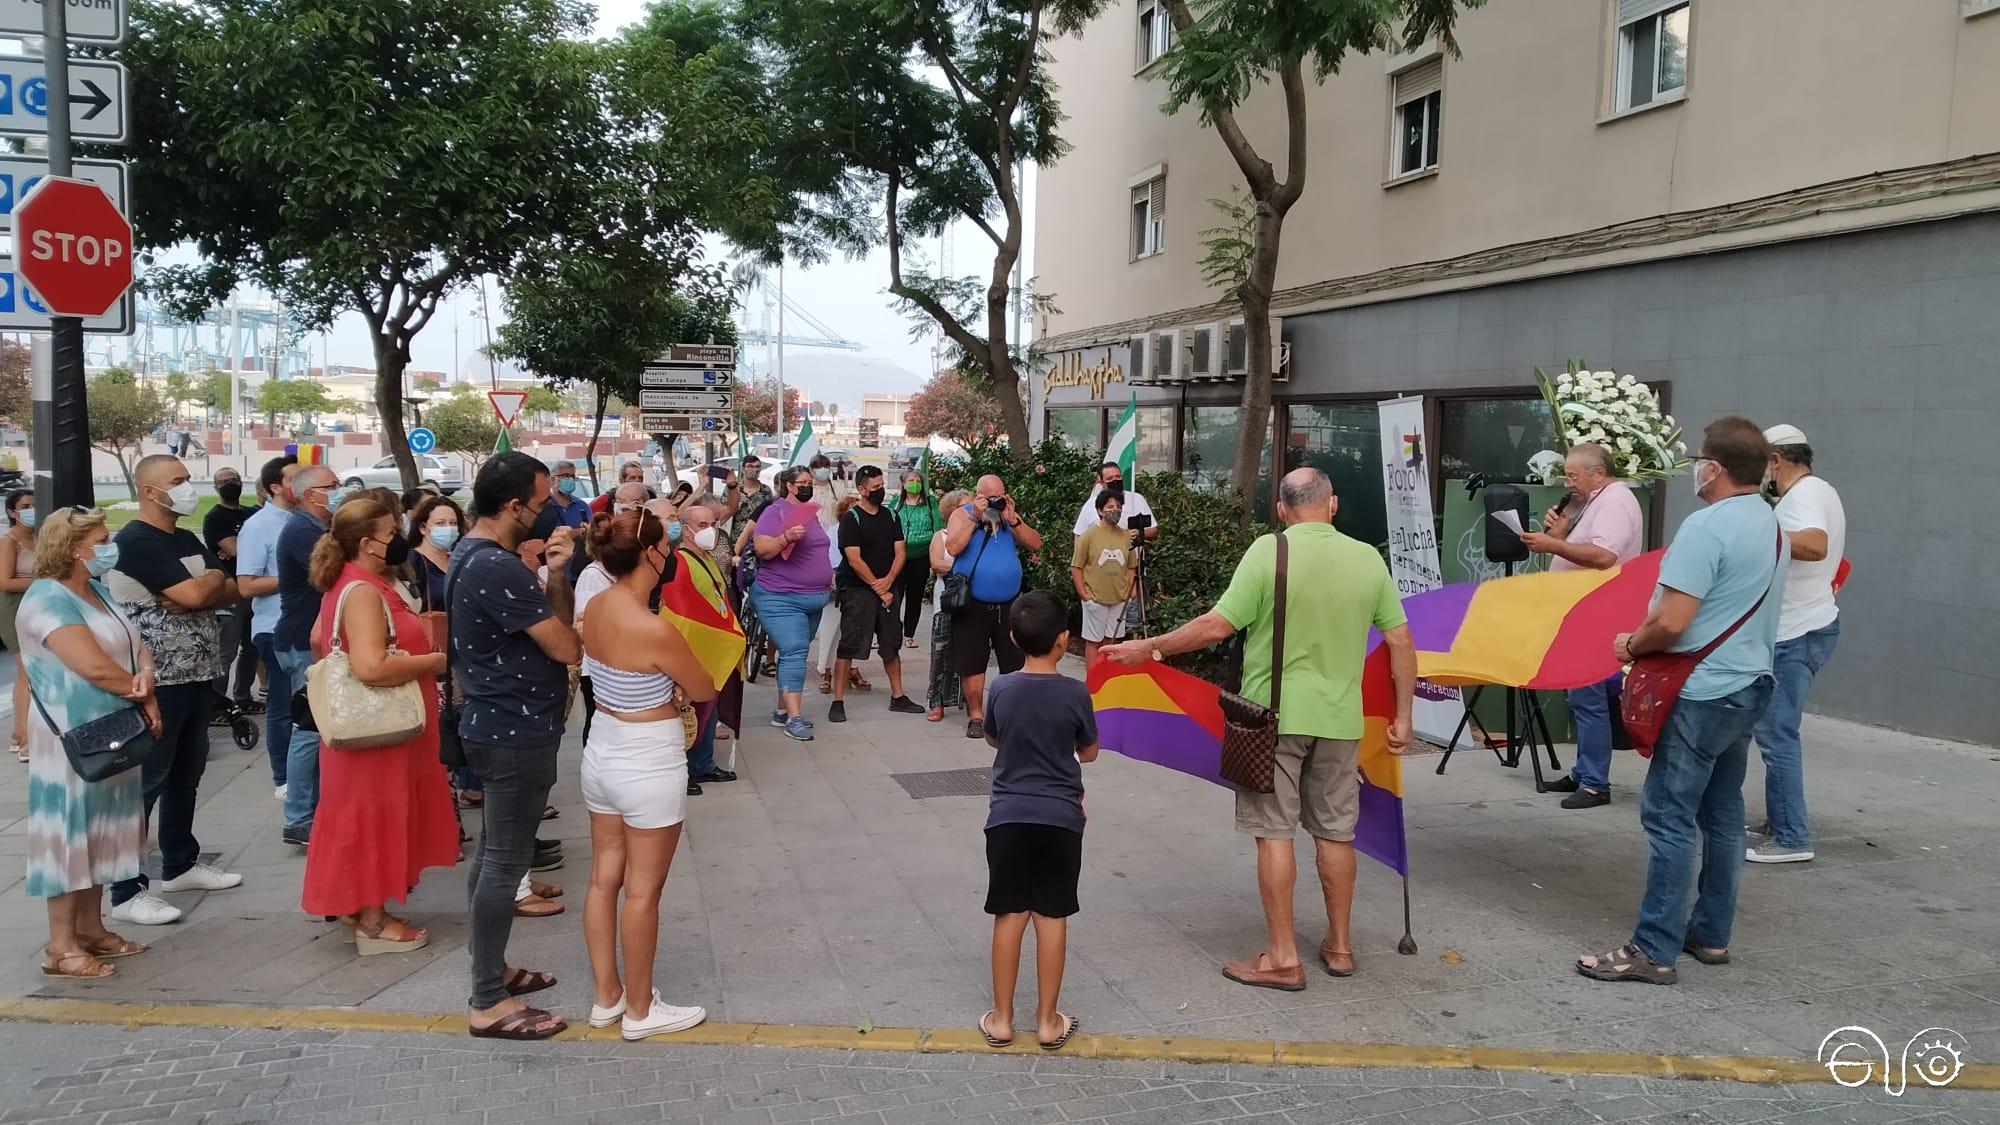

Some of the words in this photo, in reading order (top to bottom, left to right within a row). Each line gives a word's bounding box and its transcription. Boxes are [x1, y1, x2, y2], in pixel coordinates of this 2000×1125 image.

[31, 229, 122, 266] STOP
[686, 353, 730, 361] Rinconcillo
[1387, 464, 1415, 491] Foro
[1400, 523, 1434, 552] lucha
[1398, 579, 1430, 593] contra
